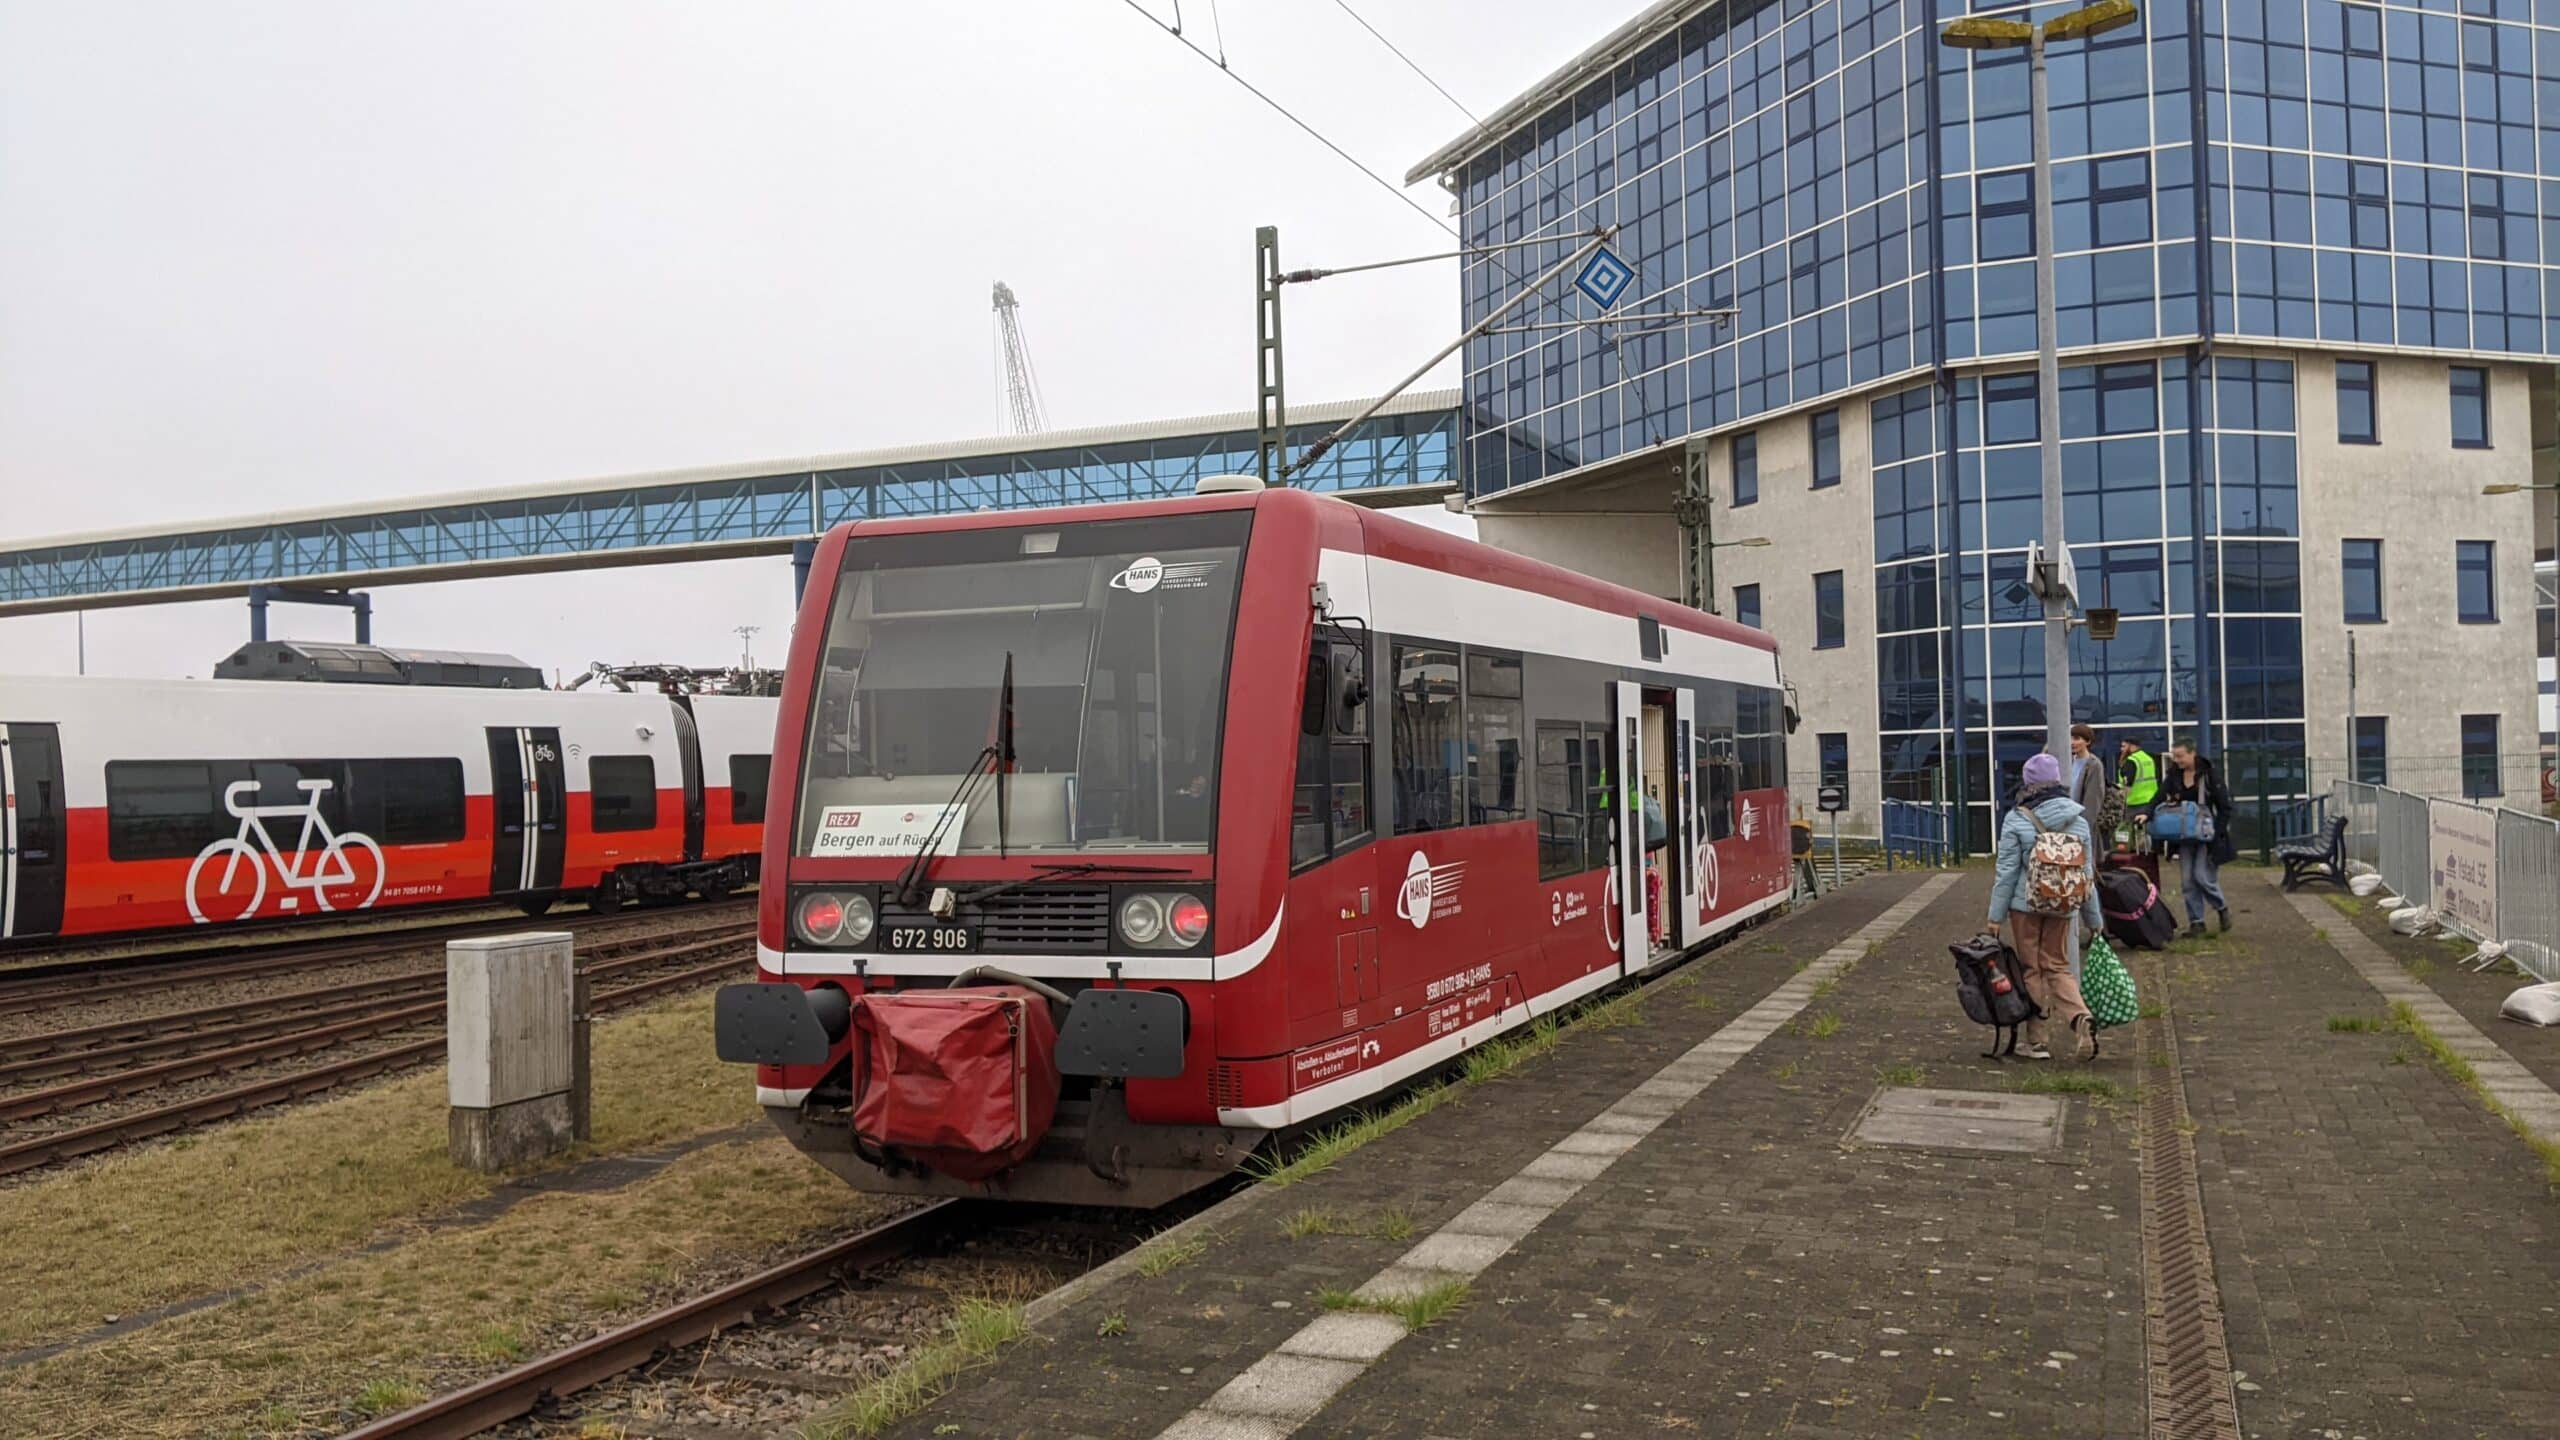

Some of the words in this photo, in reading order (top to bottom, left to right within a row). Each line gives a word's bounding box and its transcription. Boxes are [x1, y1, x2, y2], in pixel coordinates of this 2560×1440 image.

[1129, 569, 1158, 580] HANS
[828, 813, 859, 827] RE27
[820, 832, 874, 850] Bergen
[879, 834, 901, 847] auf
[903, 833, 942, 850] Rügen
[1409, 878, 1429, 901] HANS
[892, 928, 926, 949] 672
[932, 928, 967, 949] 906
